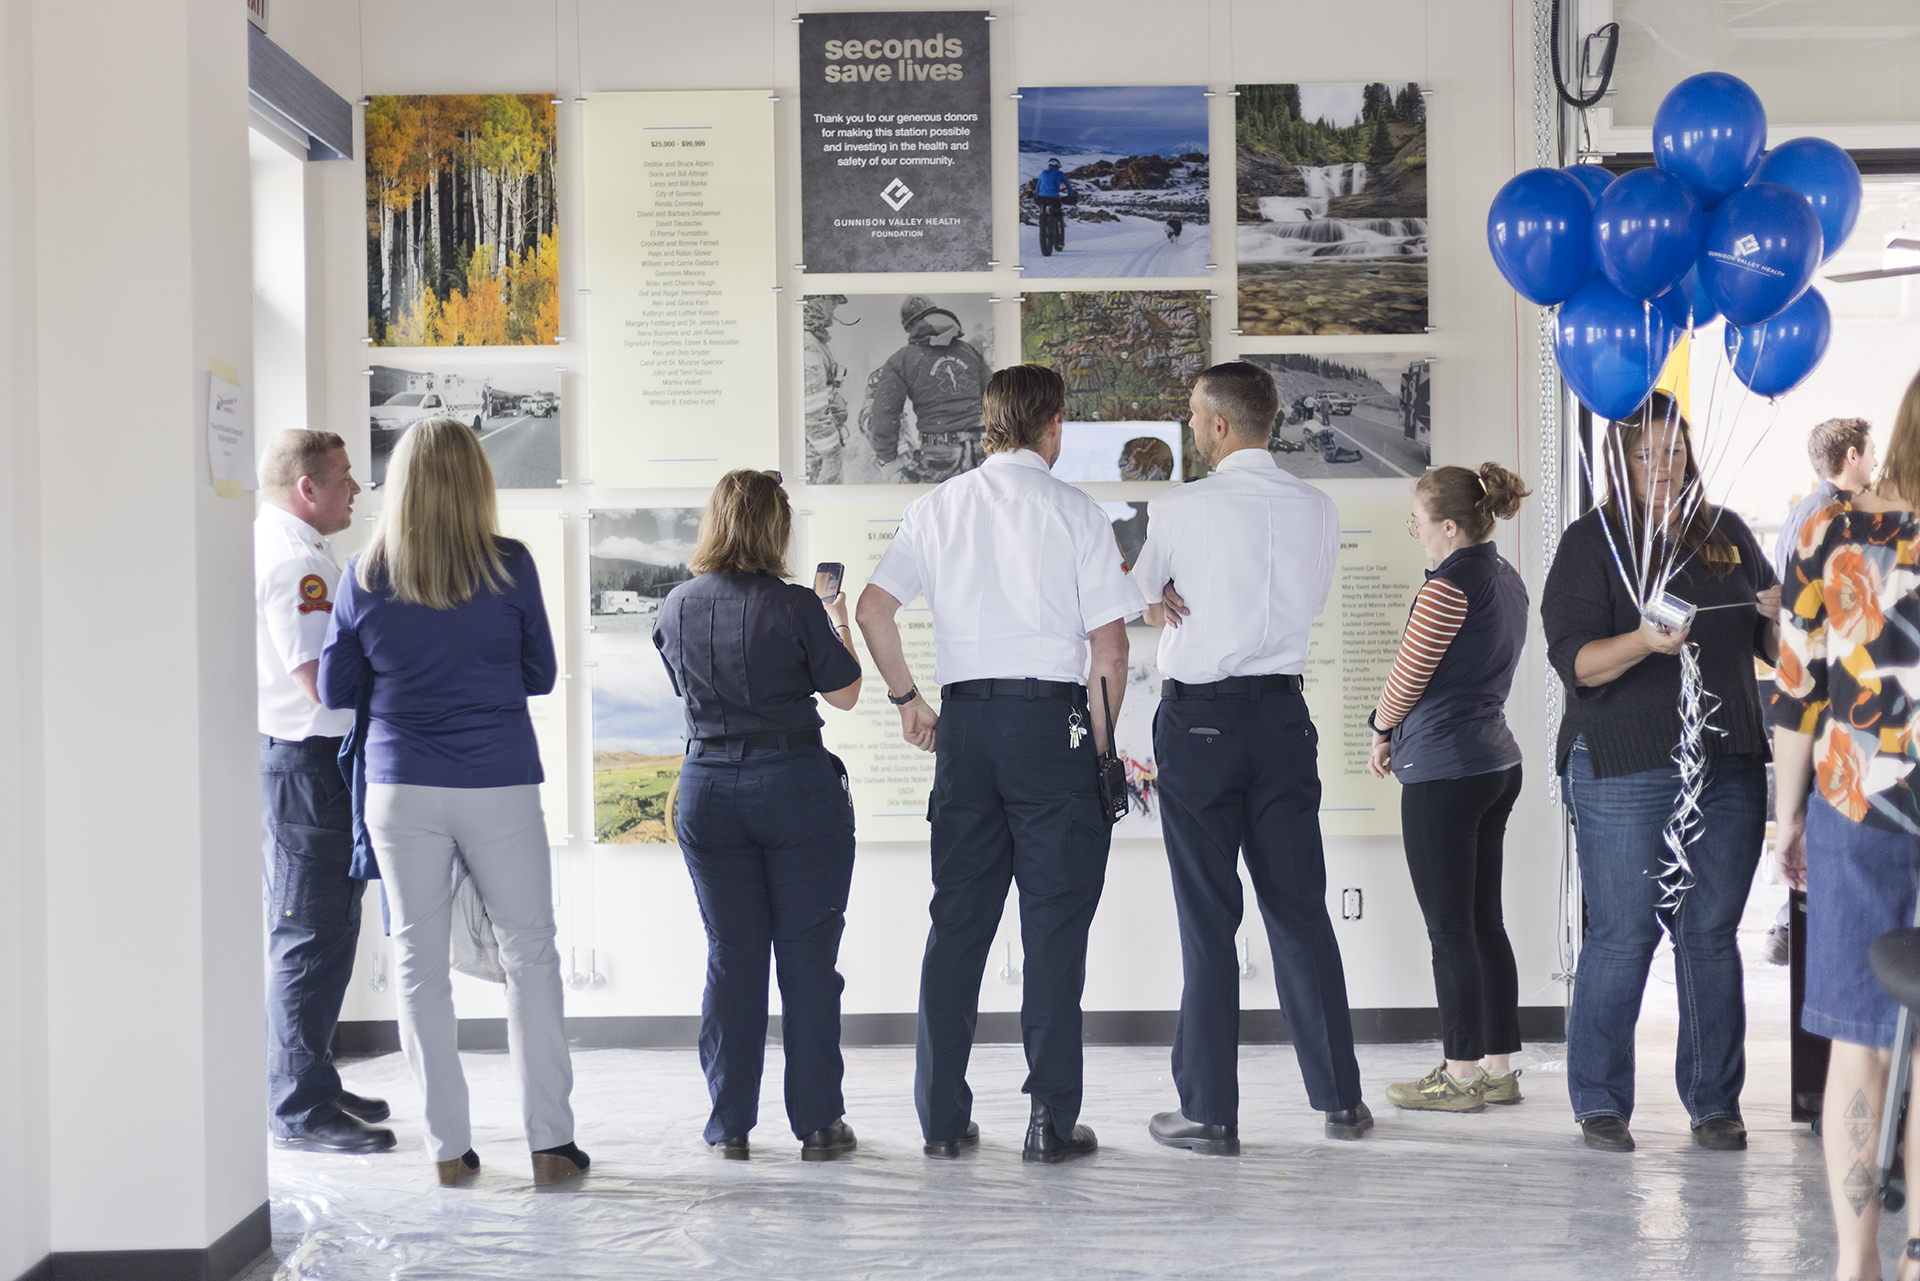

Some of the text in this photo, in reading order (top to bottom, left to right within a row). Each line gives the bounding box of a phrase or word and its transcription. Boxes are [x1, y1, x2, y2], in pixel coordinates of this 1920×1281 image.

[825, 33, 963, 60] seconds
[825, 59, 963, 83] save lives
[814, 114, 843, 123] Thank
[846, 116, 864, 125] you
[866, 114, 876, 123] to
[897, 114, 942, 125] generous
[944, 112, 978, 121] donors
[822, 127, 970, 139] for making this station possible
[651, 140, 675, 149] $25,000
[681, 140, 706, 148] $99,999
[823, 141, 969, 153] and investing in the health and
[695, 160, 714, 168] Alpern
[837, 157, 866, 167] safety
[869, 156, 879, 165] of
[900, 156, 955, 166] community.
[674, 200, 704, 208] Connaway
[834, 219, 886, 227] GUNNISON
[647, 250, 662, 258] Hays
[1708, 251, 1786, 277] GUNNISON VALLEY HEALTH
[625, 320, 649, 328] Margery
